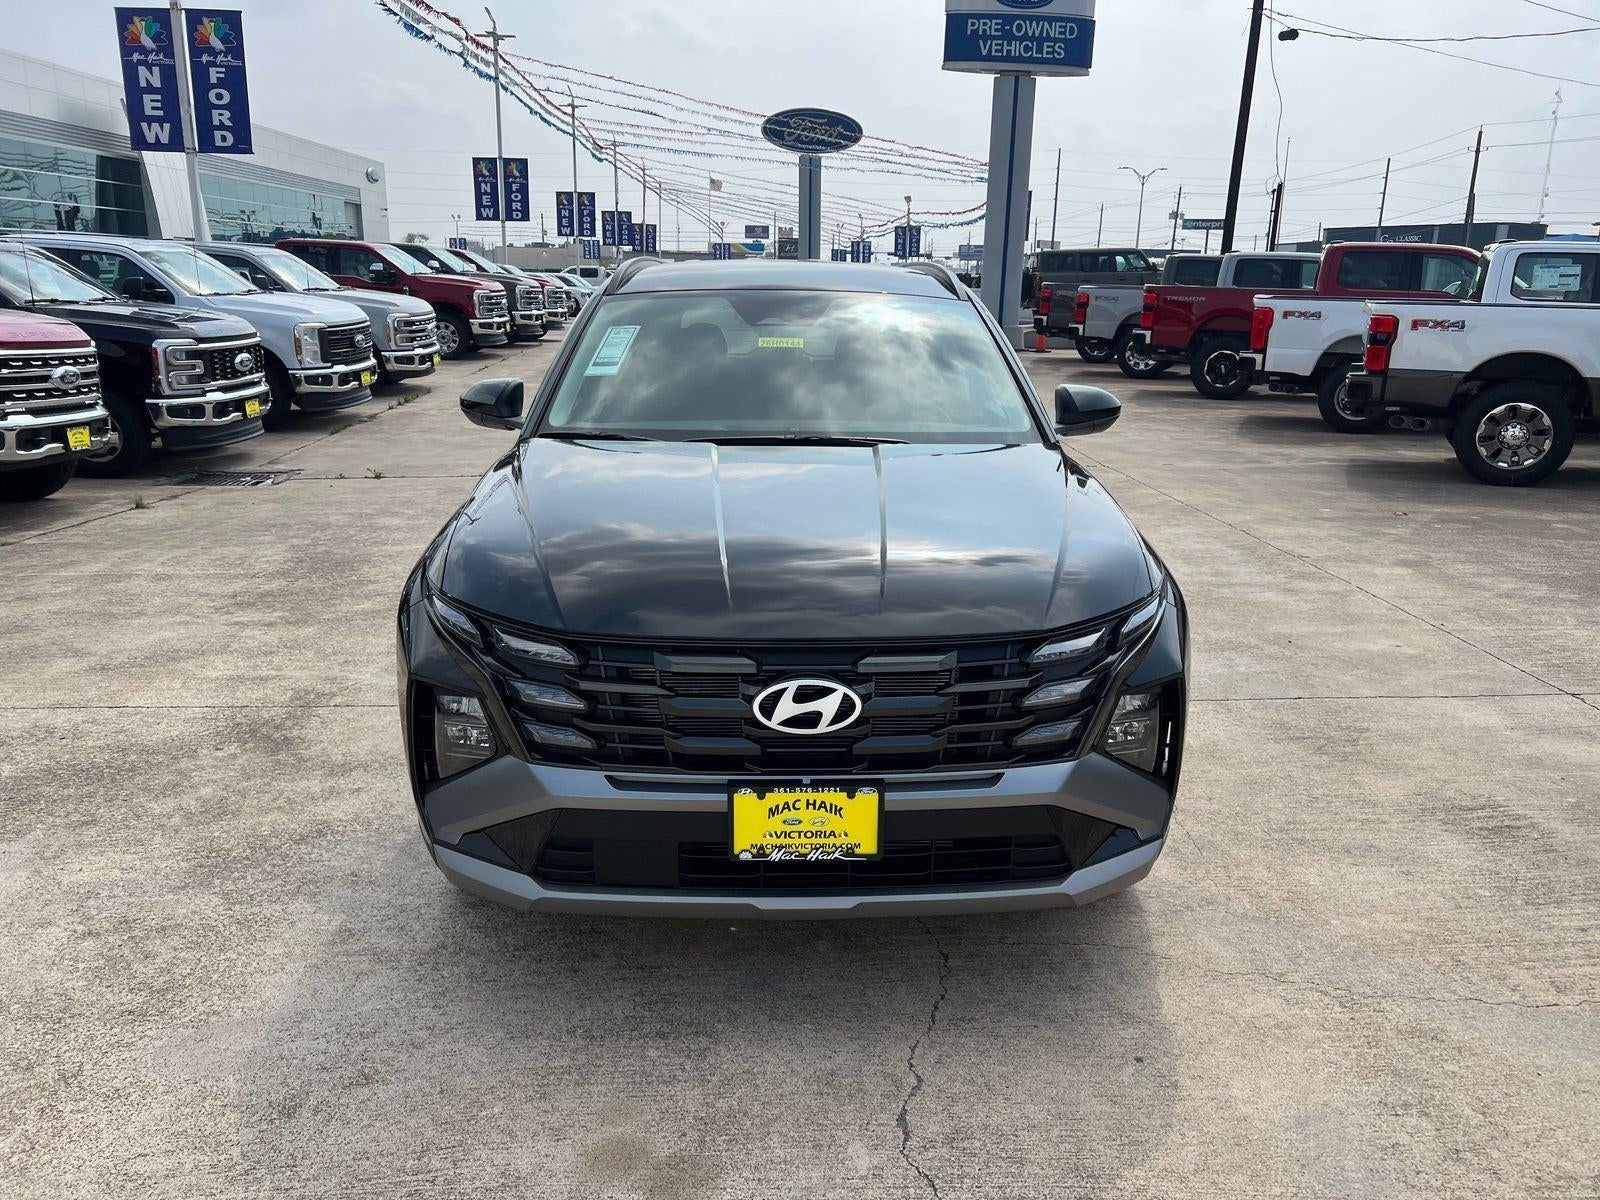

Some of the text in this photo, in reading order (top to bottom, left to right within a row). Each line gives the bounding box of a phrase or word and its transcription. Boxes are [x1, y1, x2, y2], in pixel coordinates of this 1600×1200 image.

[979, 39, 1066, 59] VEHICLES
[137, 65, 171, 144] NEW
[208, 66, 234, 147] FORD
[480, 182, 494, 218] NEW
[511, 183, 522, 219] FORD
[561, 209, 571, 235] NEW
[582, 209, 591, 236] FORD
[1187, 220, 1224, 228] enterpri
[605, 224, 613, 244] NEW
[1282, 310, 1322, 319] FX4
[1410, 319, 1466, 331] FX4
[767, 798, 844, 820] MAC HAIK
[774, 830, 837, 840] VICTORIA
[766, 848, 846, 861] Mac Haik
